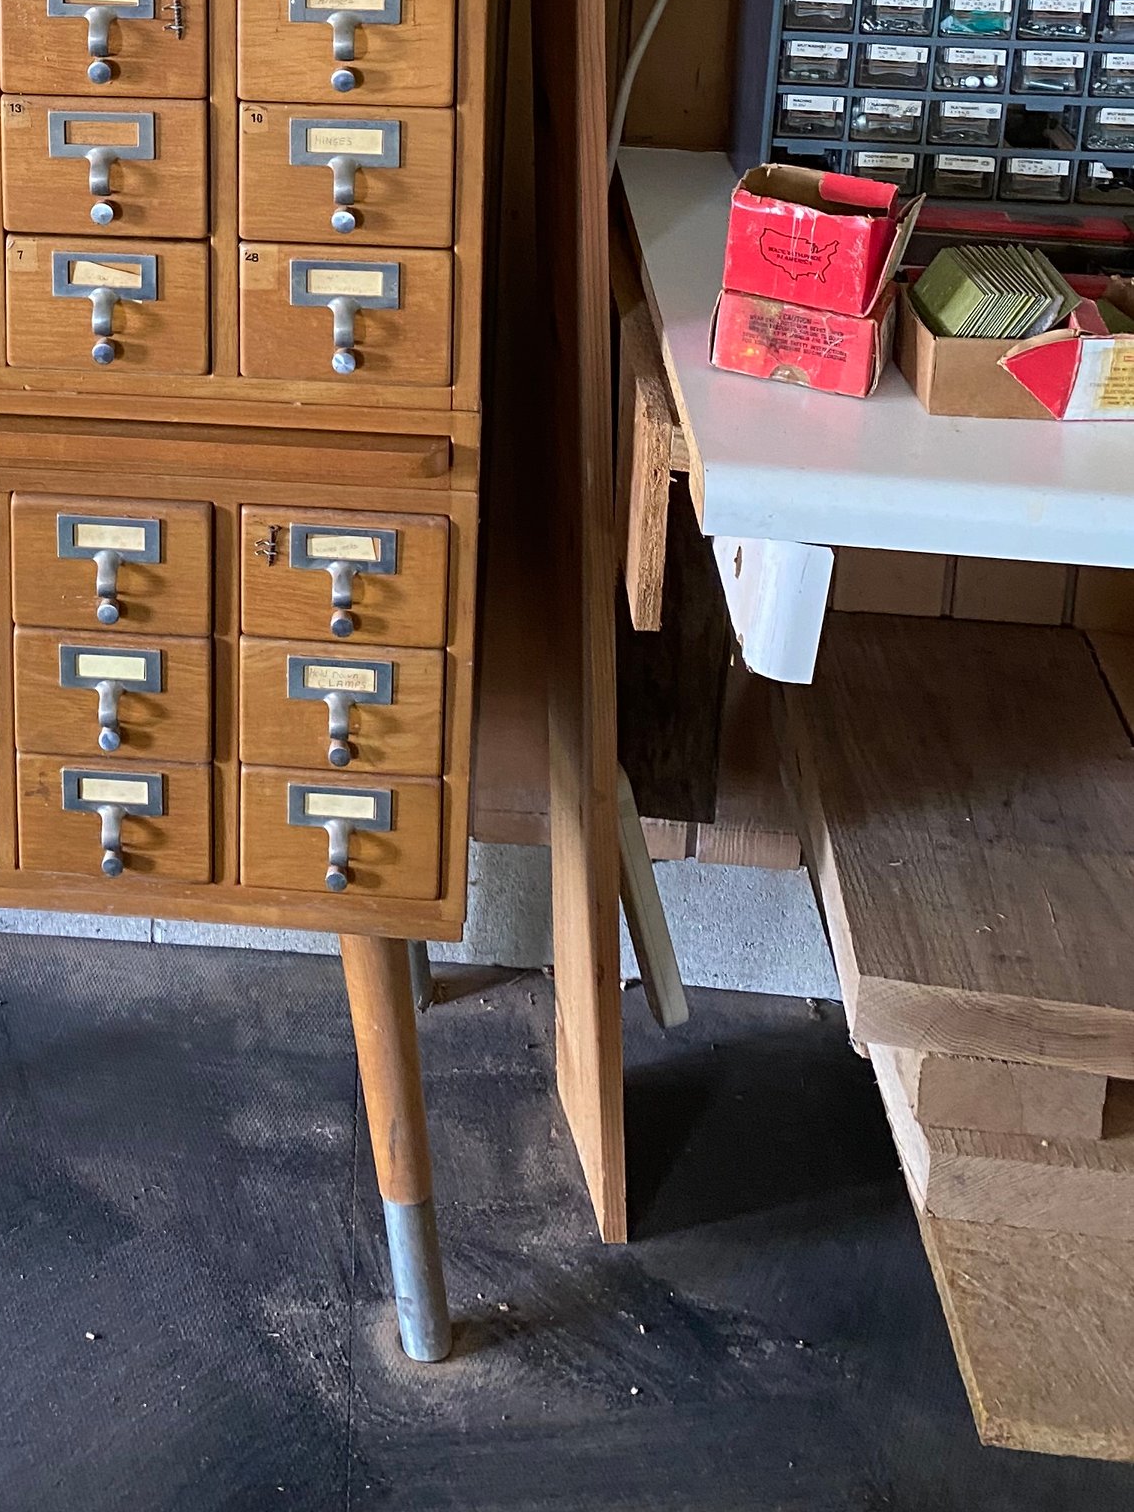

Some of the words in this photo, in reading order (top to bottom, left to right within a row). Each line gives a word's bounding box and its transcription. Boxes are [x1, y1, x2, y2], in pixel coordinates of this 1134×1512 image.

[9, 104, 22, 113] 13
[250, 113, 262, 124] 10
[16, 250, 24, 260] 7
[782, 314, 812, 324] CAUTION
[318, 680, 367, 690] CLAMPS
